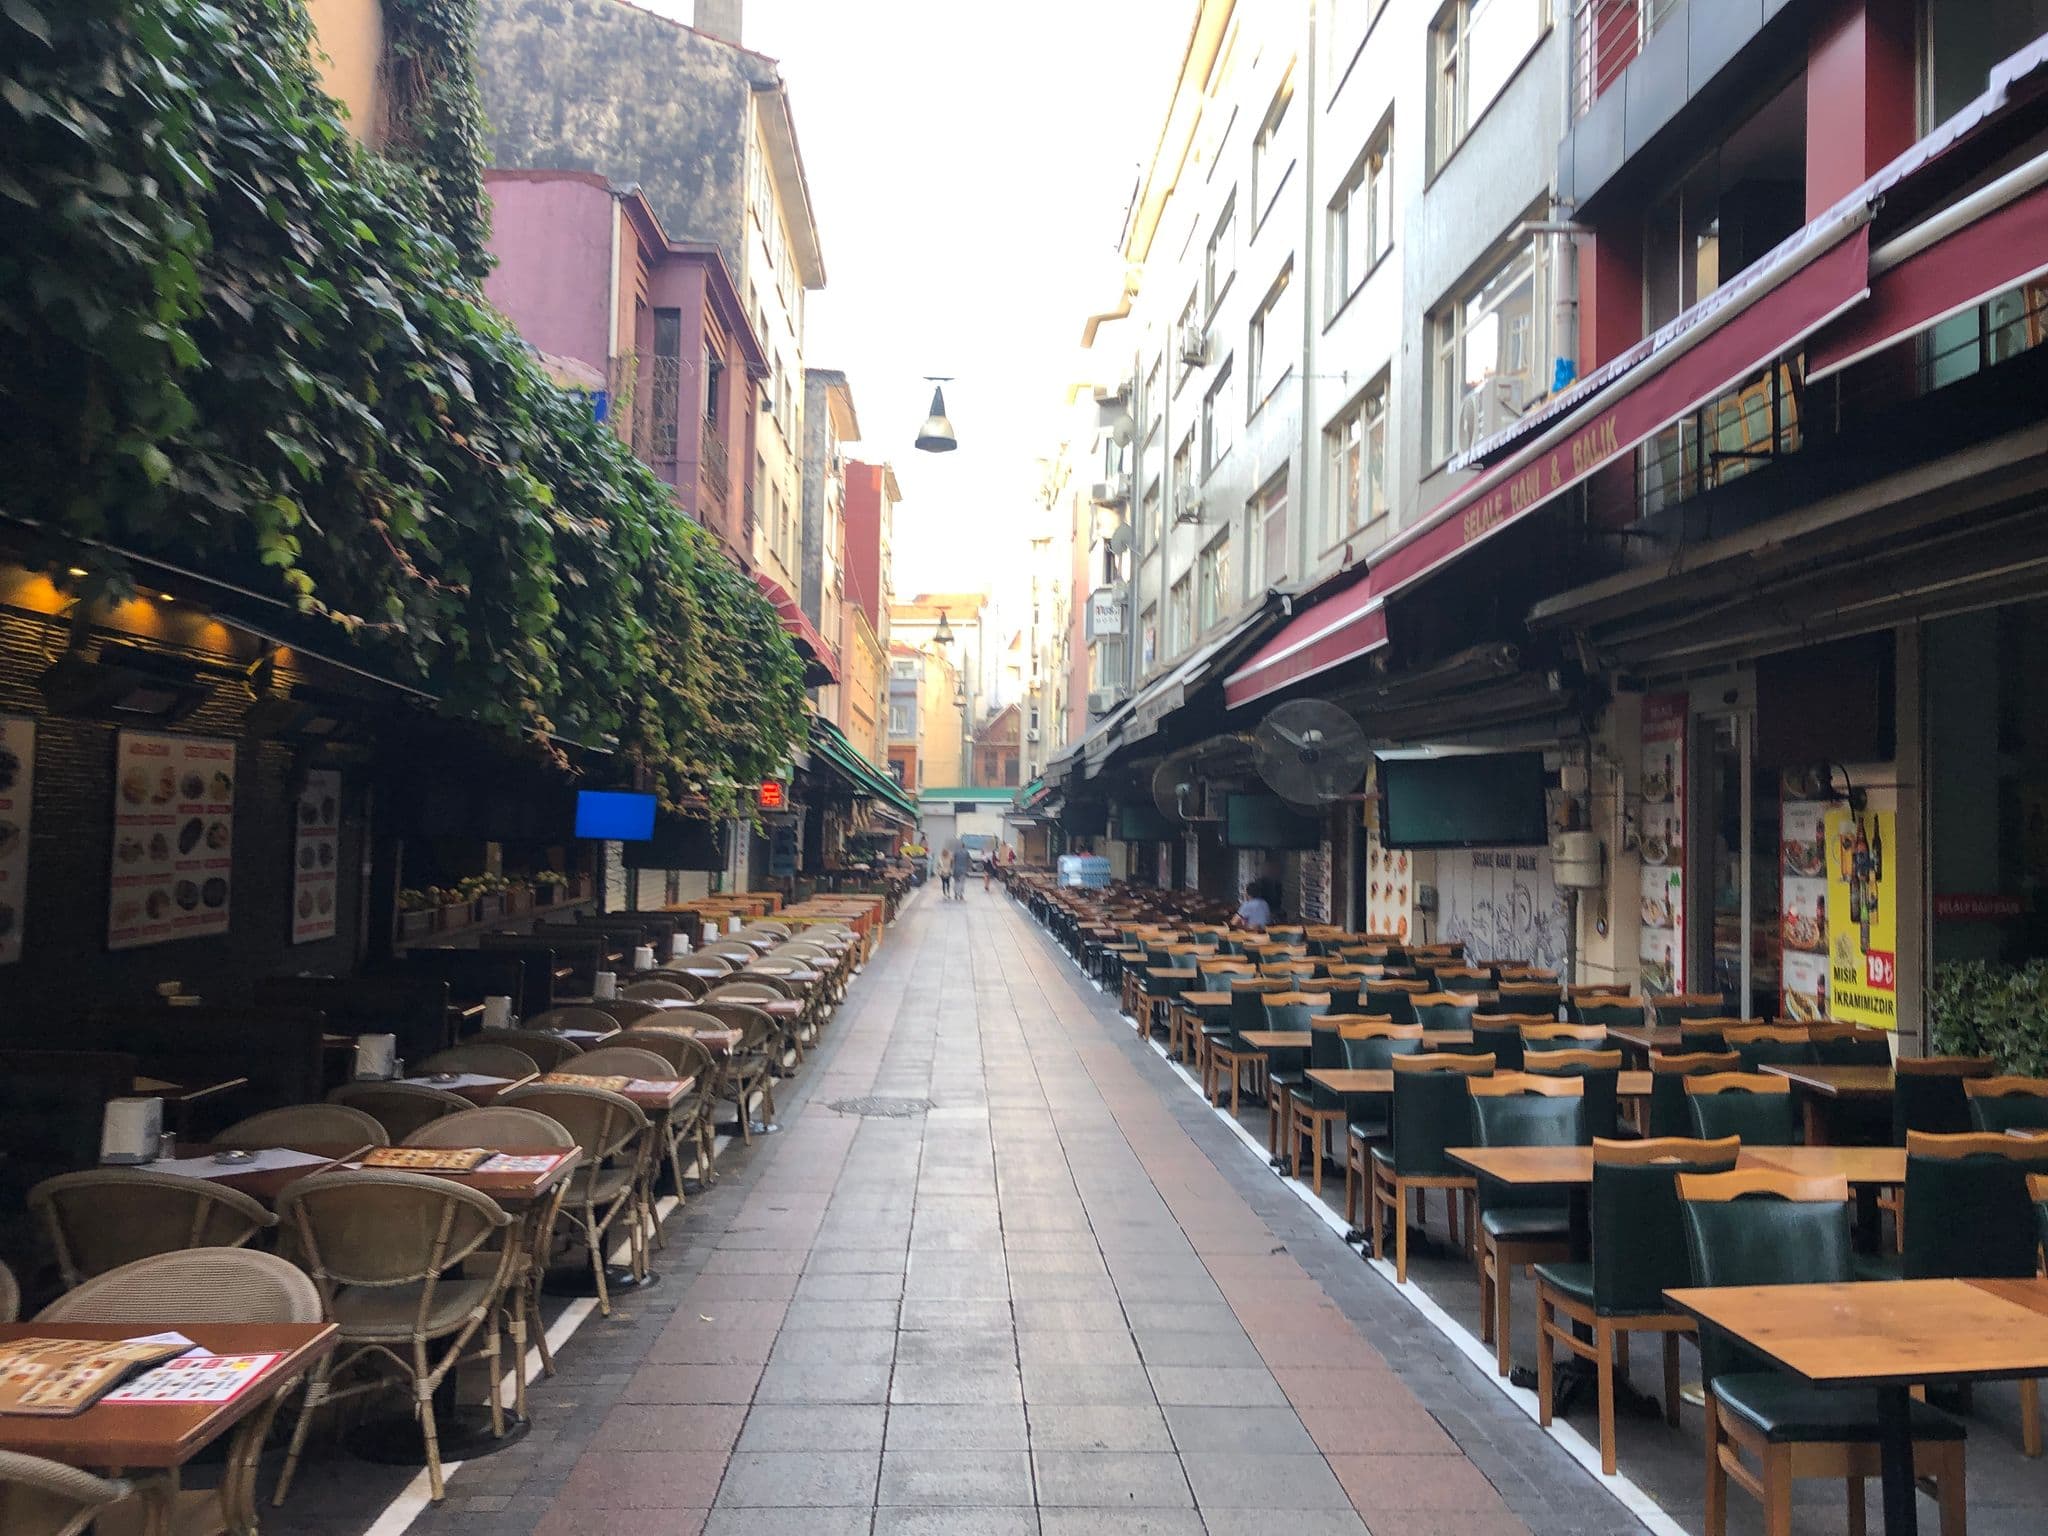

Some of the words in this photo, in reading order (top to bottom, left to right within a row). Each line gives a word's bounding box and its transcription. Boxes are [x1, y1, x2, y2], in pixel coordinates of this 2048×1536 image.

[1510, 467, 1540, 514] RAKI
[1550, 454, 1562, 489] &
[1573, 415, 1619, 475] BALIK
[1833, 965, 1858, 985] MISIR
